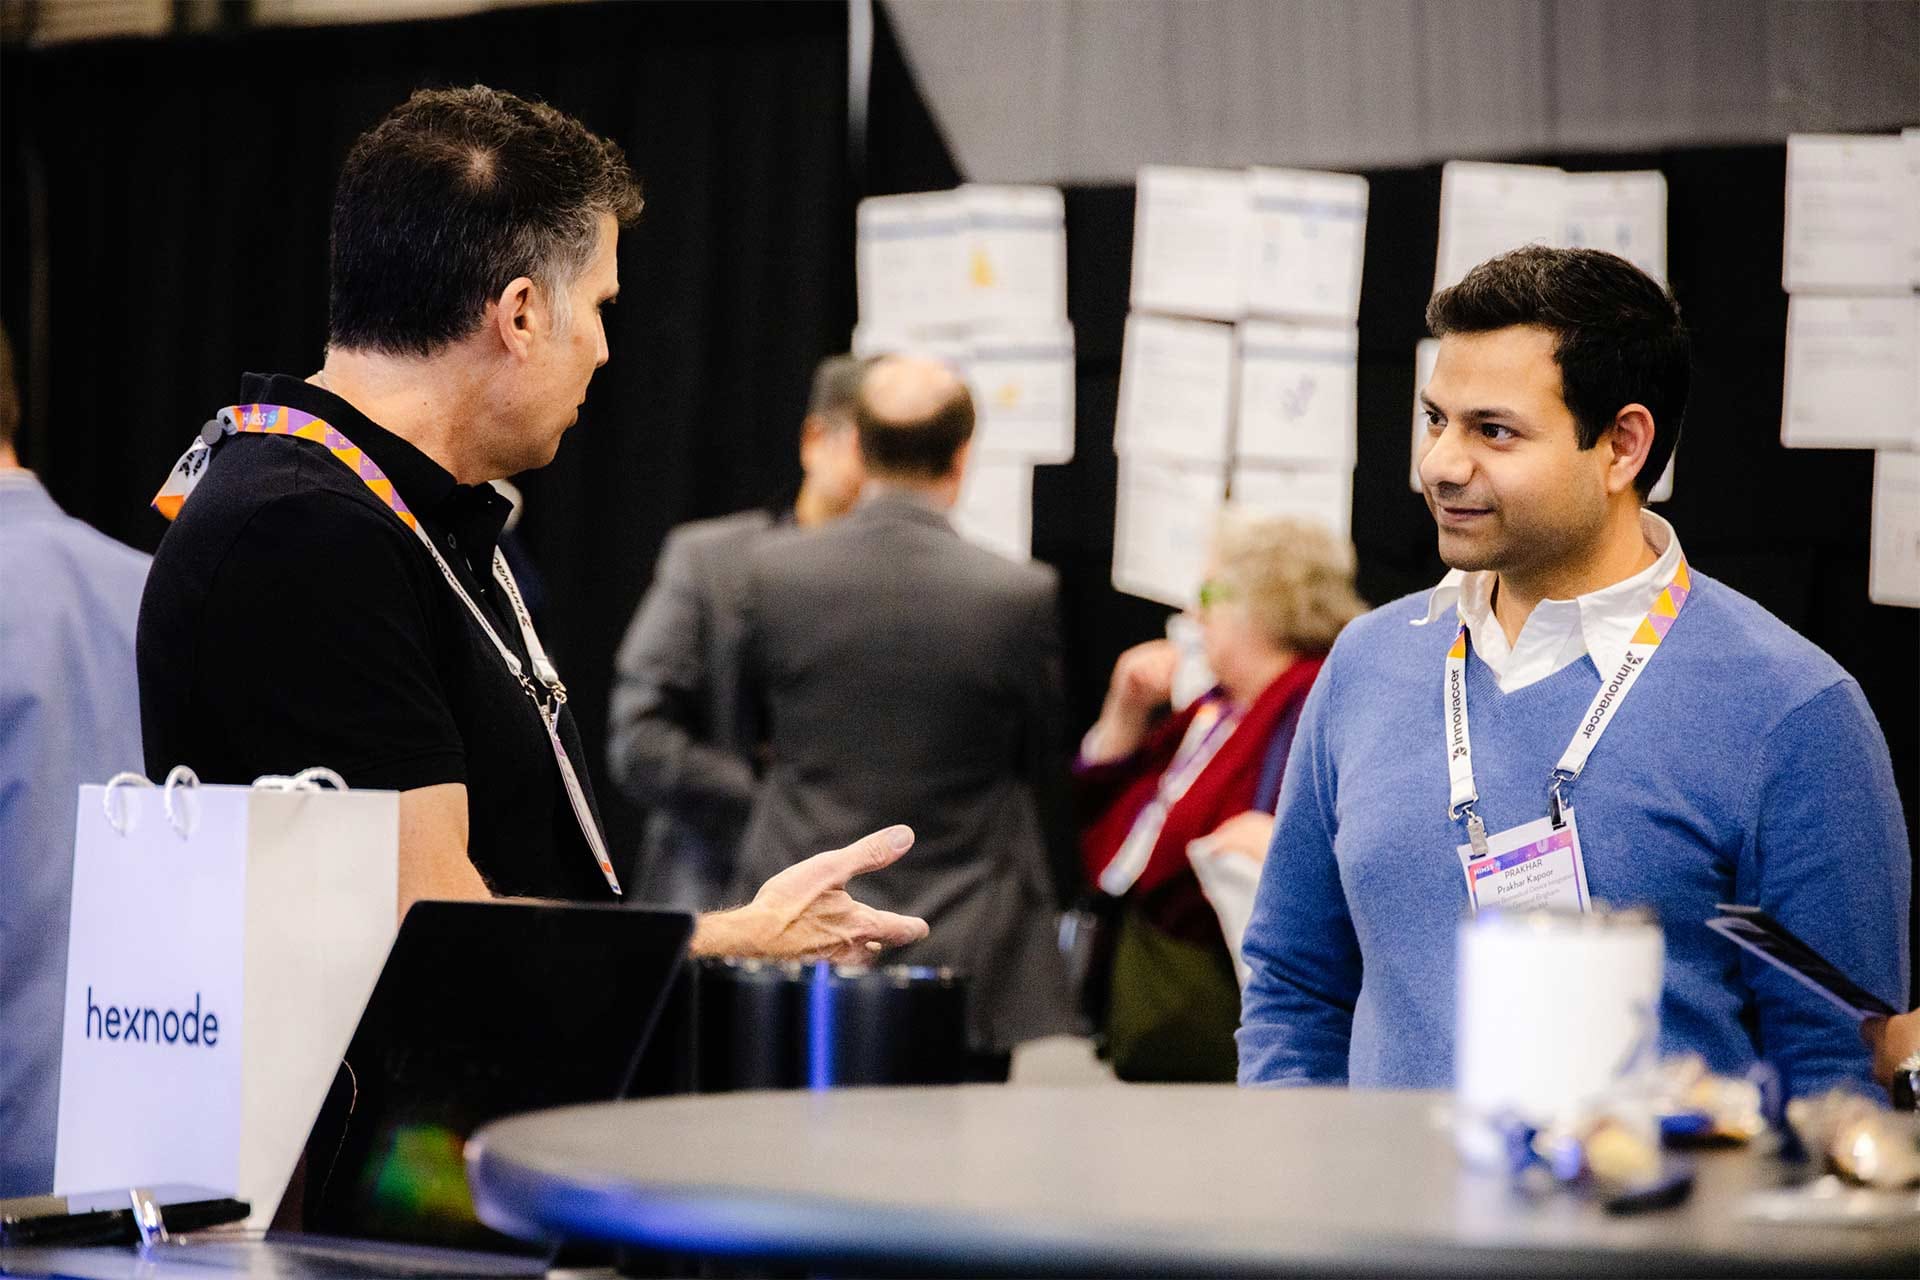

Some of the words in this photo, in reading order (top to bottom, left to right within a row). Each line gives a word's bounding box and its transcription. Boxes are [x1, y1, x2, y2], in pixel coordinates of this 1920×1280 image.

[1451, 669, 1463, 747] innovaccer
[1582, 664, 1632, 739] innovaccer
[1497, 880, 1525, 895] Prakhar
[1526, 870, 1554, 884] Kapoor
[1504, 859, 1543, 879] PRAKHAR
[87, 986, 218, 1046] hexnode
